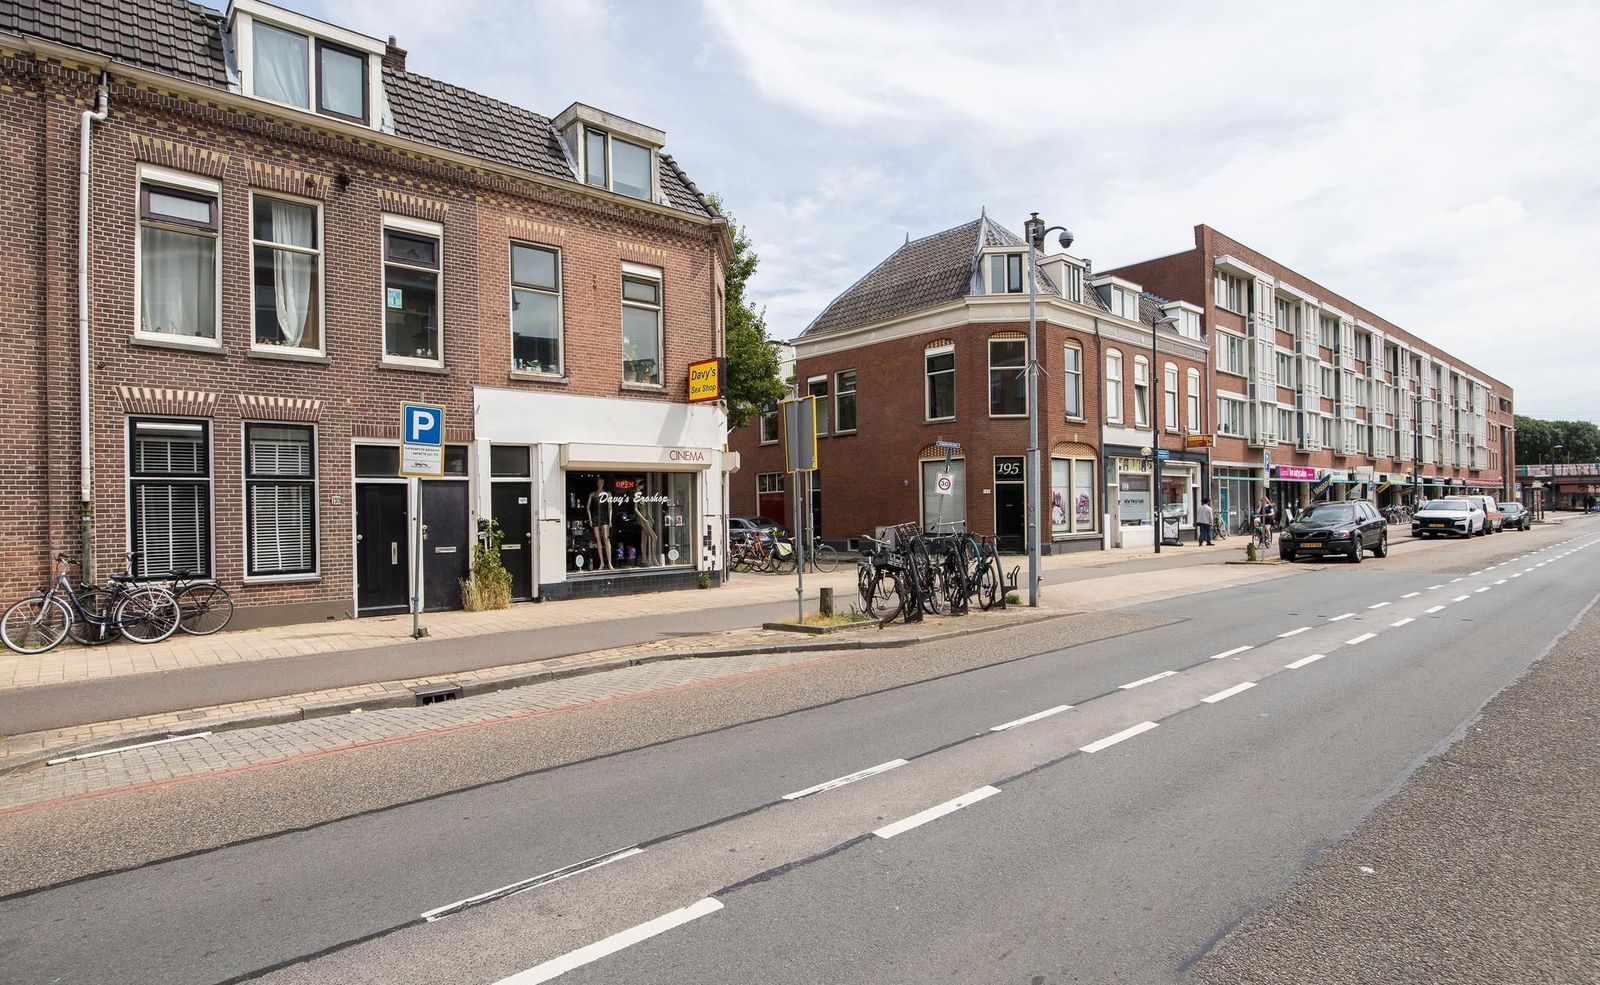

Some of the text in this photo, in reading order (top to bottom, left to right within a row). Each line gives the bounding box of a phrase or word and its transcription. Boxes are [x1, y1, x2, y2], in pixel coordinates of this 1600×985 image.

[691, 367, 716, 381] Davy's
[691, 384, 716, 394] Sex Shop
[412, 410, 435, 440] P
[669, 449, 704, 461] CINEMA
[1265, 453, 1270, 467] P
[998, 462, 1019, 475] 195
[615, 480, 634, 488] OPEN
[598, 491, 668, 506] Davy's Eroshop
